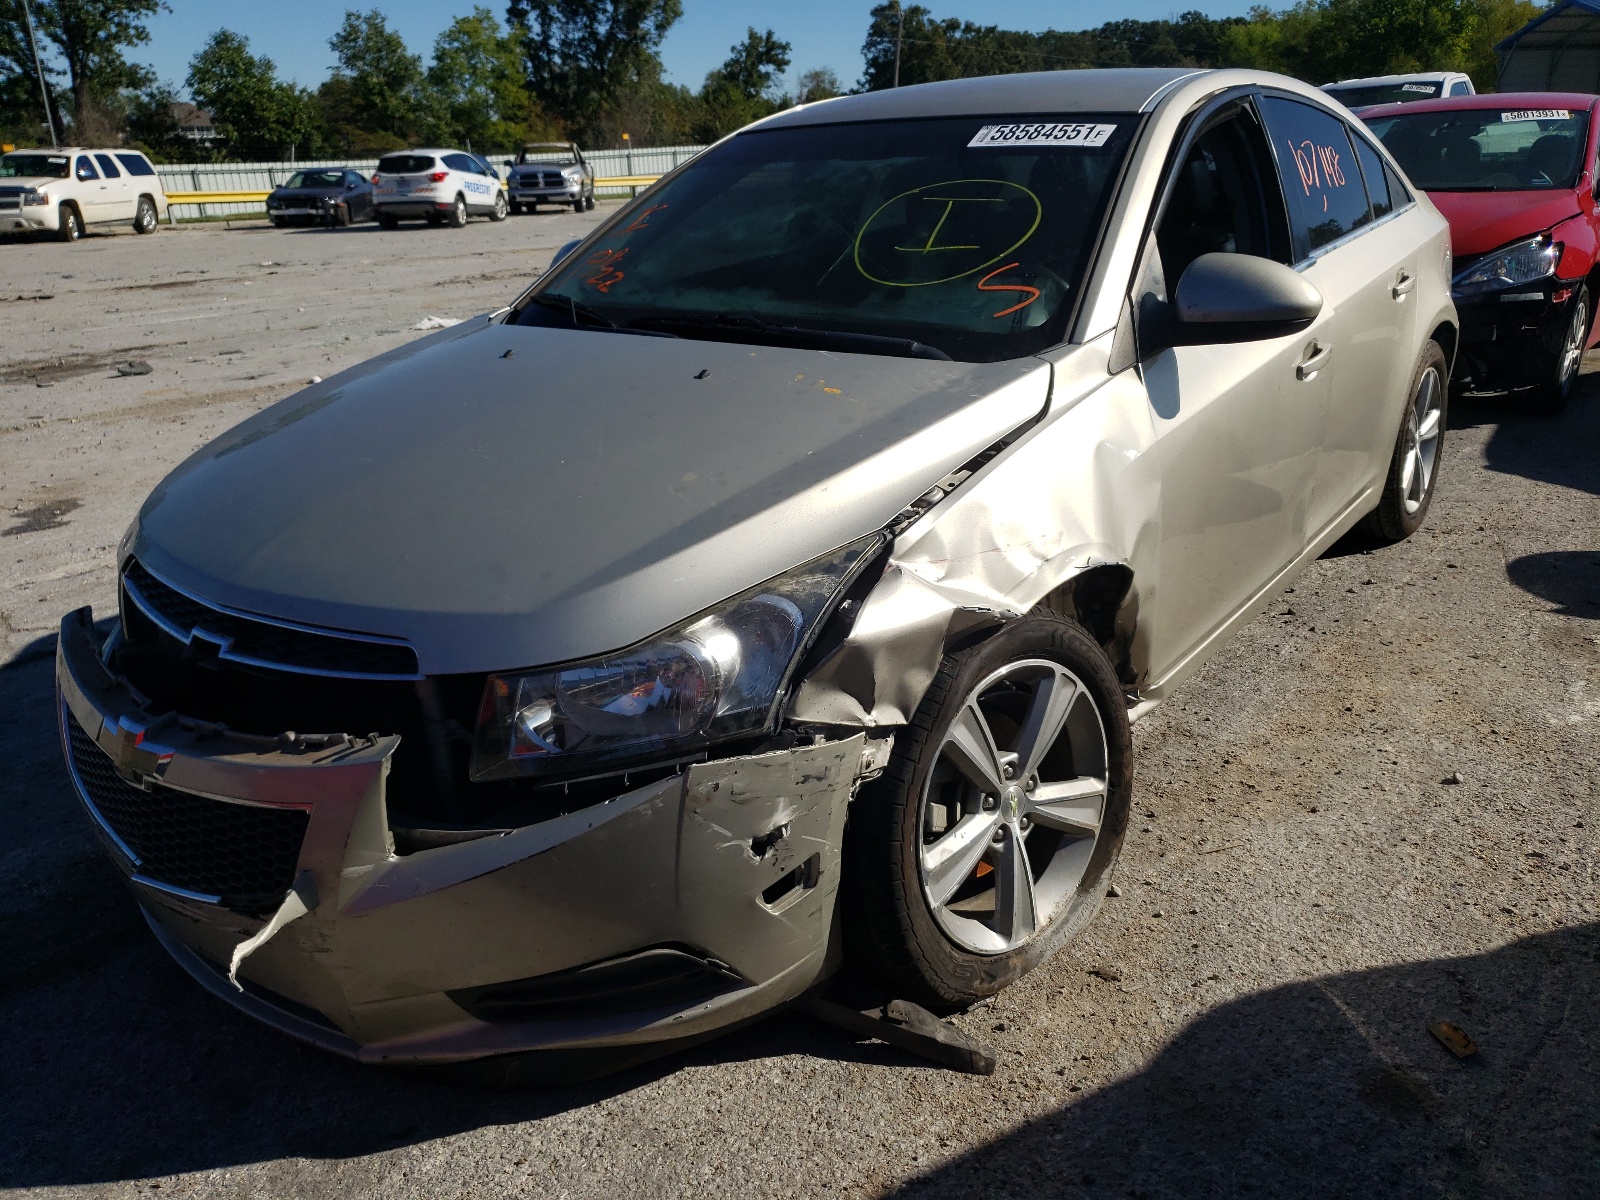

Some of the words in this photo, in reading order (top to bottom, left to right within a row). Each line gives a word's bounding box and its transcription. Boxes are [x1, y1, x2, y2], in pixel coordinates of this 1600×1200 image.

[1510, 110, 1560, 120] 58013931
[990, 124, 1098, 141] 58584551
[1093, 130, 1106, 139] F
[977, 261, 1041, 319] S
